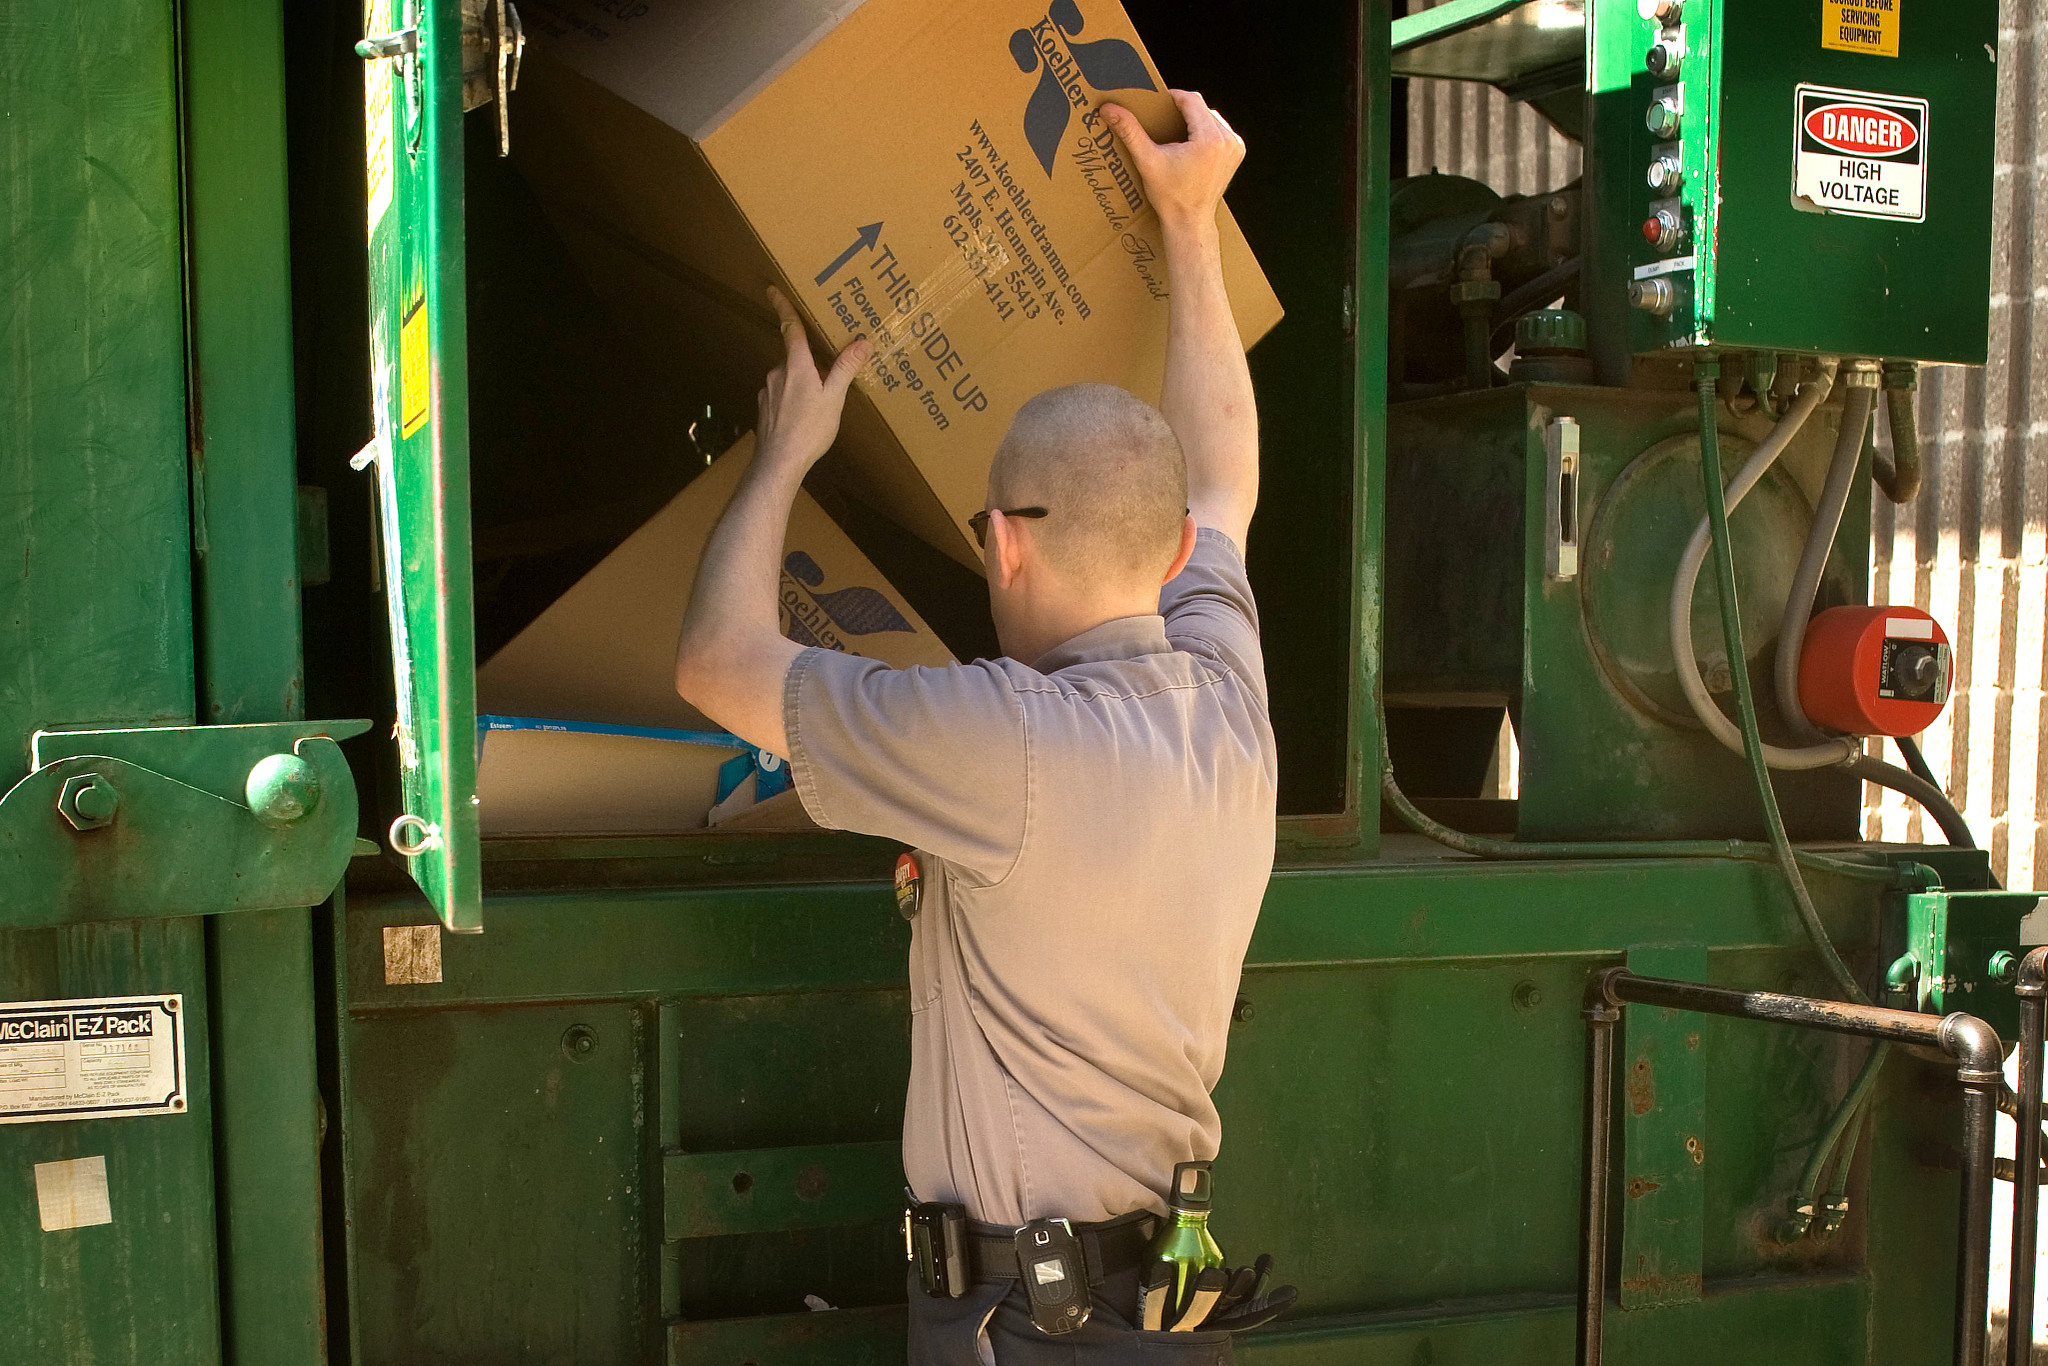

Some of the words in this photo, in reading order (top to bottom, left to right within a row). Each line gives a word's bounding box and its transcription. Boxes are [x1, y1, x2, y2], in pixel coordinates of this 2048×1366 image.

[1840, 26, 1881, 45] EQUIPMENT
[1841, 8, 1880, 27] SERVICING
[1030, 15, 1088, 108] Koehler
[1081, 107, 1100, 133] &
[1093, 126, 1145, 213] Dramm
[1822, 112, 1902, 148] DANGER
[1840, 160, 1881, 181] HIGH
[1819, 180, 1899, 206] VOLTAGE
[956, 145, 990, 187] 2407
[982, 186, 1000, 212] E.
[995, 207, 1048, 291] Hennepin
[1042, 289, 1065, 326] Ave.
[969, 118, 1092, 321] www.koehlerdramm.com
[1072, 136, 1129, 232] Wholesale
[1121, 233, 1170, 301] Florist
[950, 180, 982, 235] Mpls.
[1005, 270, 1041, 320] 55413
[828, 290, 861, 333] heat
[870, 243, 920, 315] THIS
[911, 312, 963, 381] SIDE
[952, 373, 988, 412] UP
[871, 351, 901, 392] frost
[893, 346, 924, 391] Keep
[920, 390, 950, 431] from
[1881, 644, 1889, 684] WATLOW
[766, 752, 773, 764] 7
[106, 1015, 151, 1035] Pack
